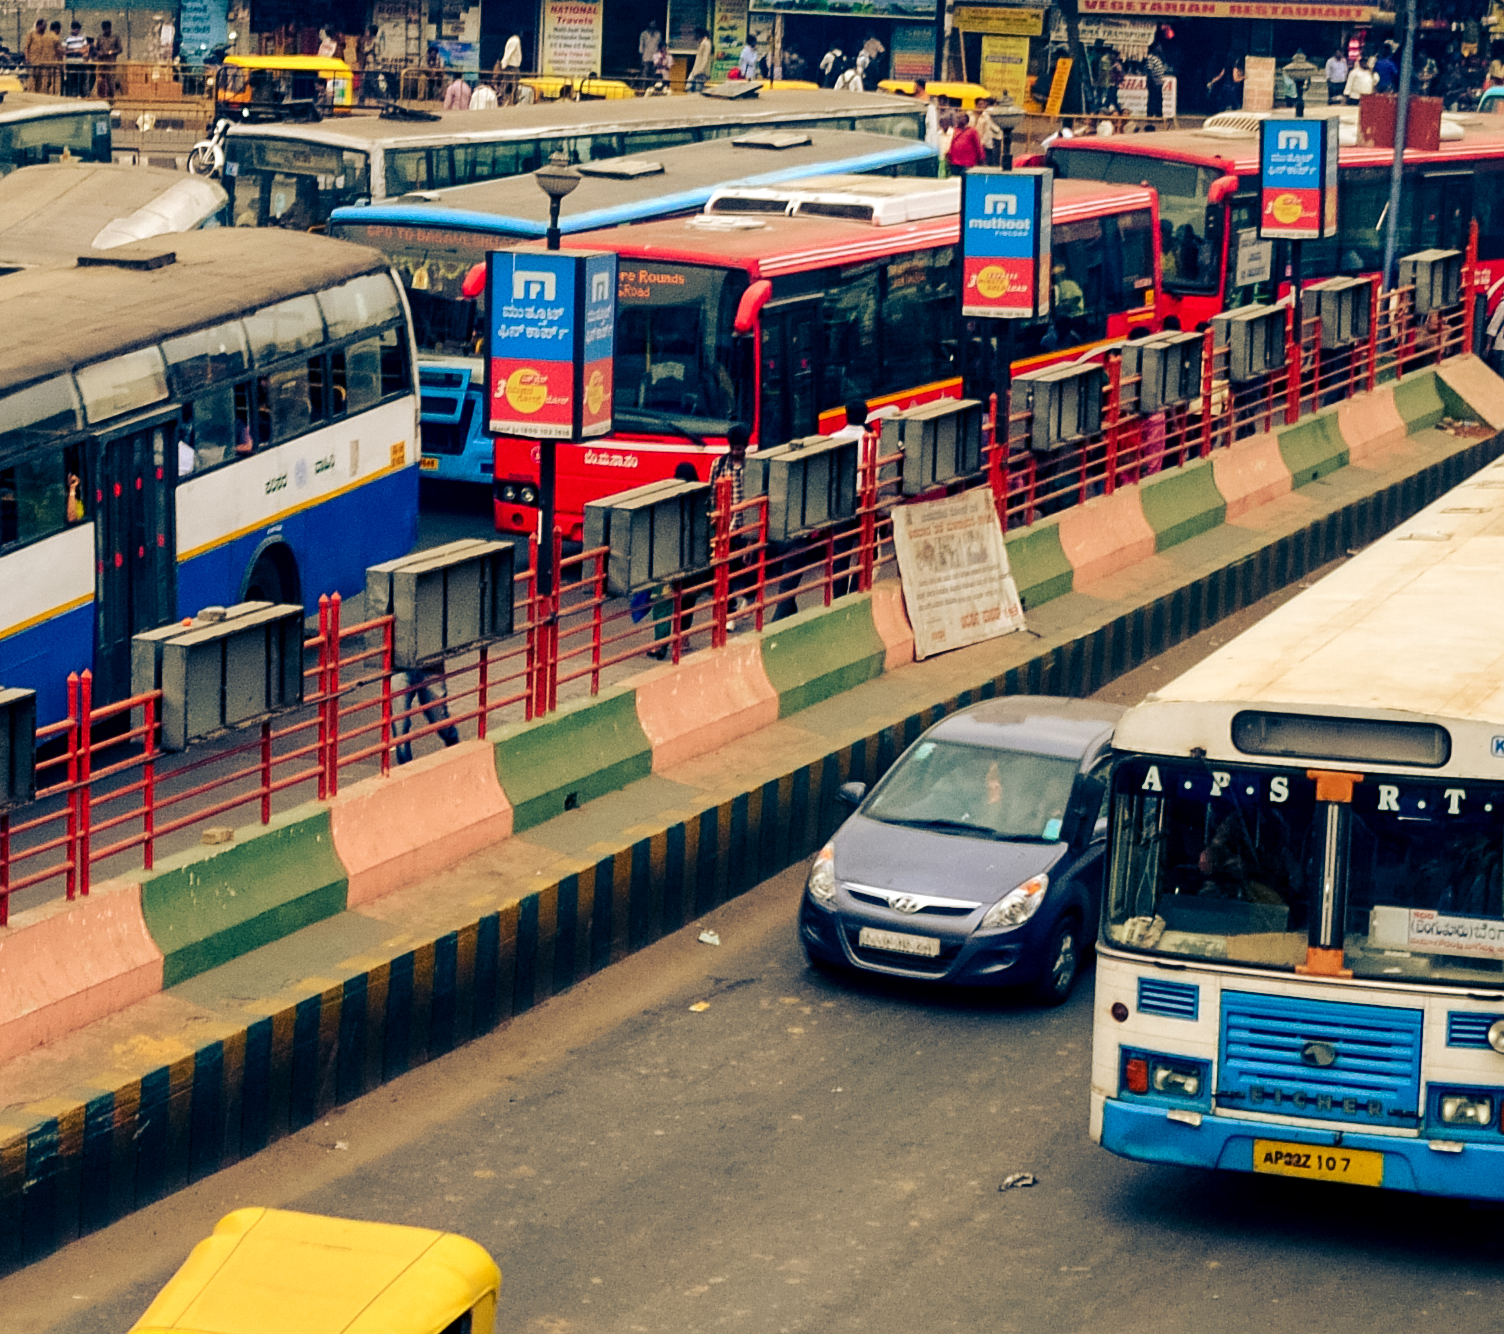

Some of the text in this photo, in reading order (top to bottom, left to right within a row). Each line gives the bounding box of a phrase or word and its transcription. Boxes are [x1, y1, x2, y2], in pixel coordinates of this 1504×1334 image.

[1084, 0, 1364, 18] VEGETARIAN RESTAURANT
[969, 218, 1031, 229] muthoot
[640, 269, 685, 285] Rounds
[494, 379, 506, 398] 3
[1250, 1085, 1383, 1116] EICHER
